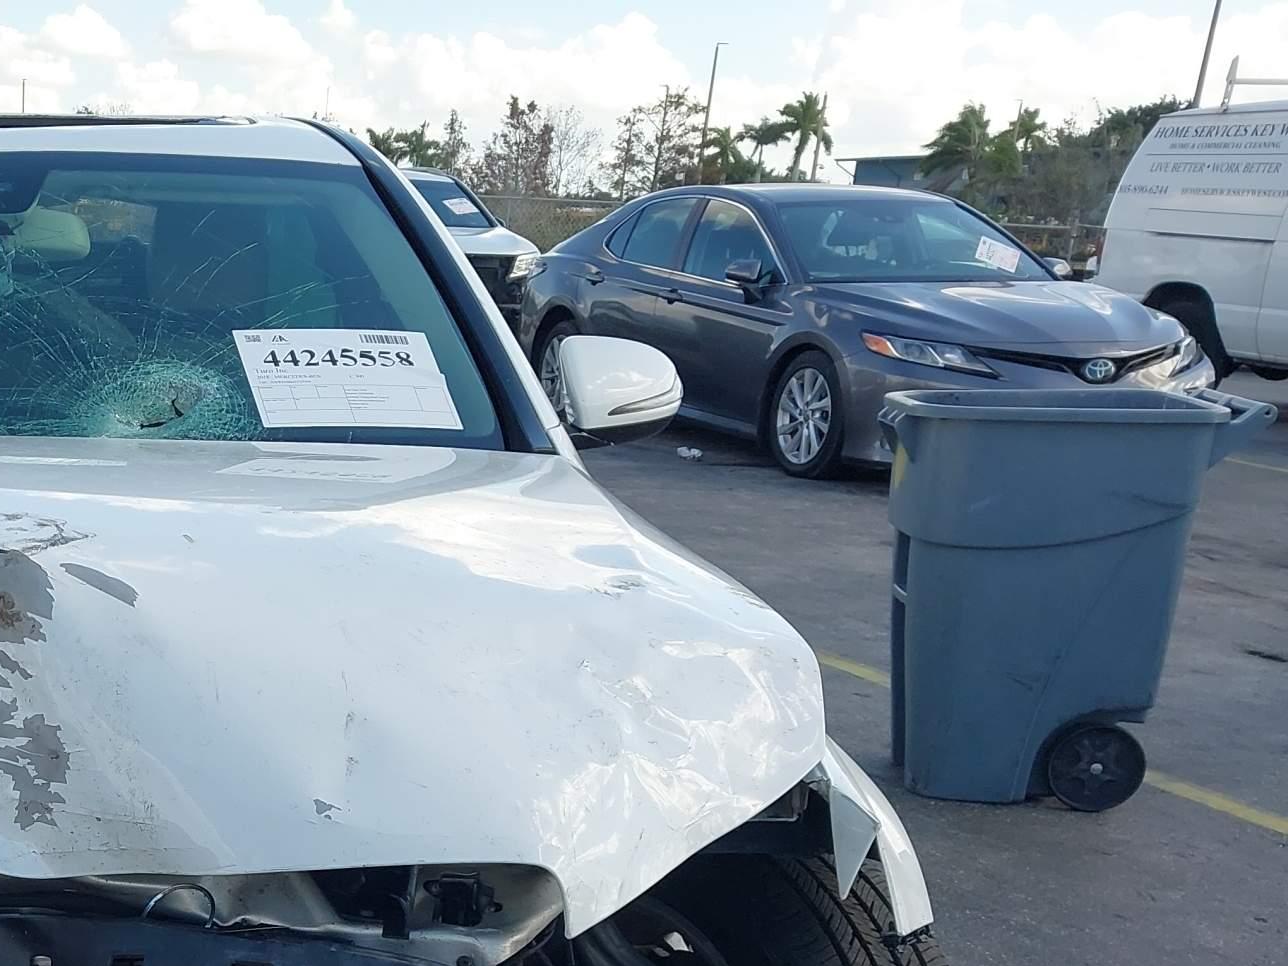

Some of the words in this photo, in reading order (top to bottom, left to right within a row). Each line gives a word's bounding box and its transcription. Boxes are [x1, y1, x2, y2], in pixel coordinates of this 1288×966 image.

[1154, 126, 1191, 138] HOME
[1192, 125, 1250, 138] SERVICES
[1251, 123, 1277, 137] KEY
[1244, 141, 1281, 149] CLEANING
[1150, 162, 1170, 173] LIVE
[1171, 162, 1205, 173] BETTER
[1211, 162, 1241, 174] WORK
[1242, 162, 1283, 174] BETTER
[263, 348, 415, 367] 44245558
